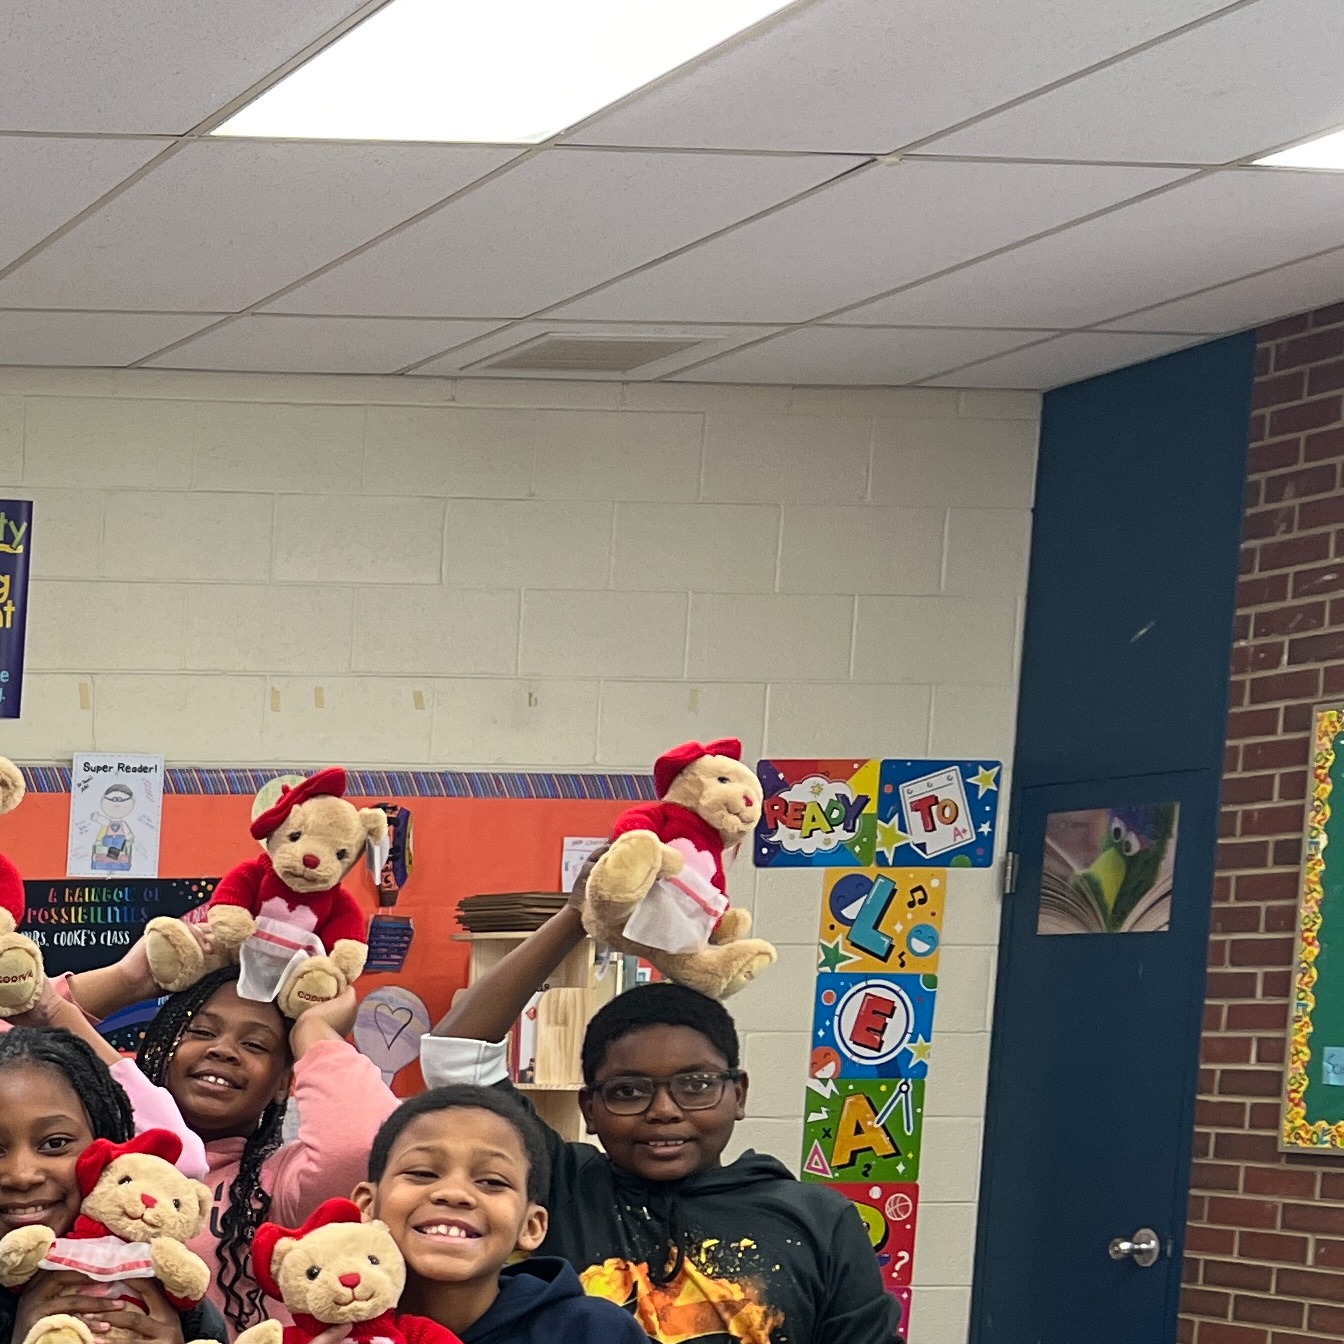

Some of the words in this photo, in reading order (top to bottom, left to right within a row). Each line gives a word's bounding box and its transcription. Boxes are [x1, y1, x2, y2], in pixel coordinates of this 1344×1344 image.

[83, 762, 114, 774] Super
[117, 763, 158, 774] Reader!
[763, 793, 870, 839] READY
[909, 795, 960, 833] TO
[64, 887, 135, 903] RAINBOW
[27, 906, 149, 924] POSSIBILITIES
[848, 873, 899, 961] L
[53, 929, 96, 946] COOKE'S
[100, 930, 130, 946] CLASS
[850, 992, 896, 1052] E
[831, 1093, 902, 1169] A
